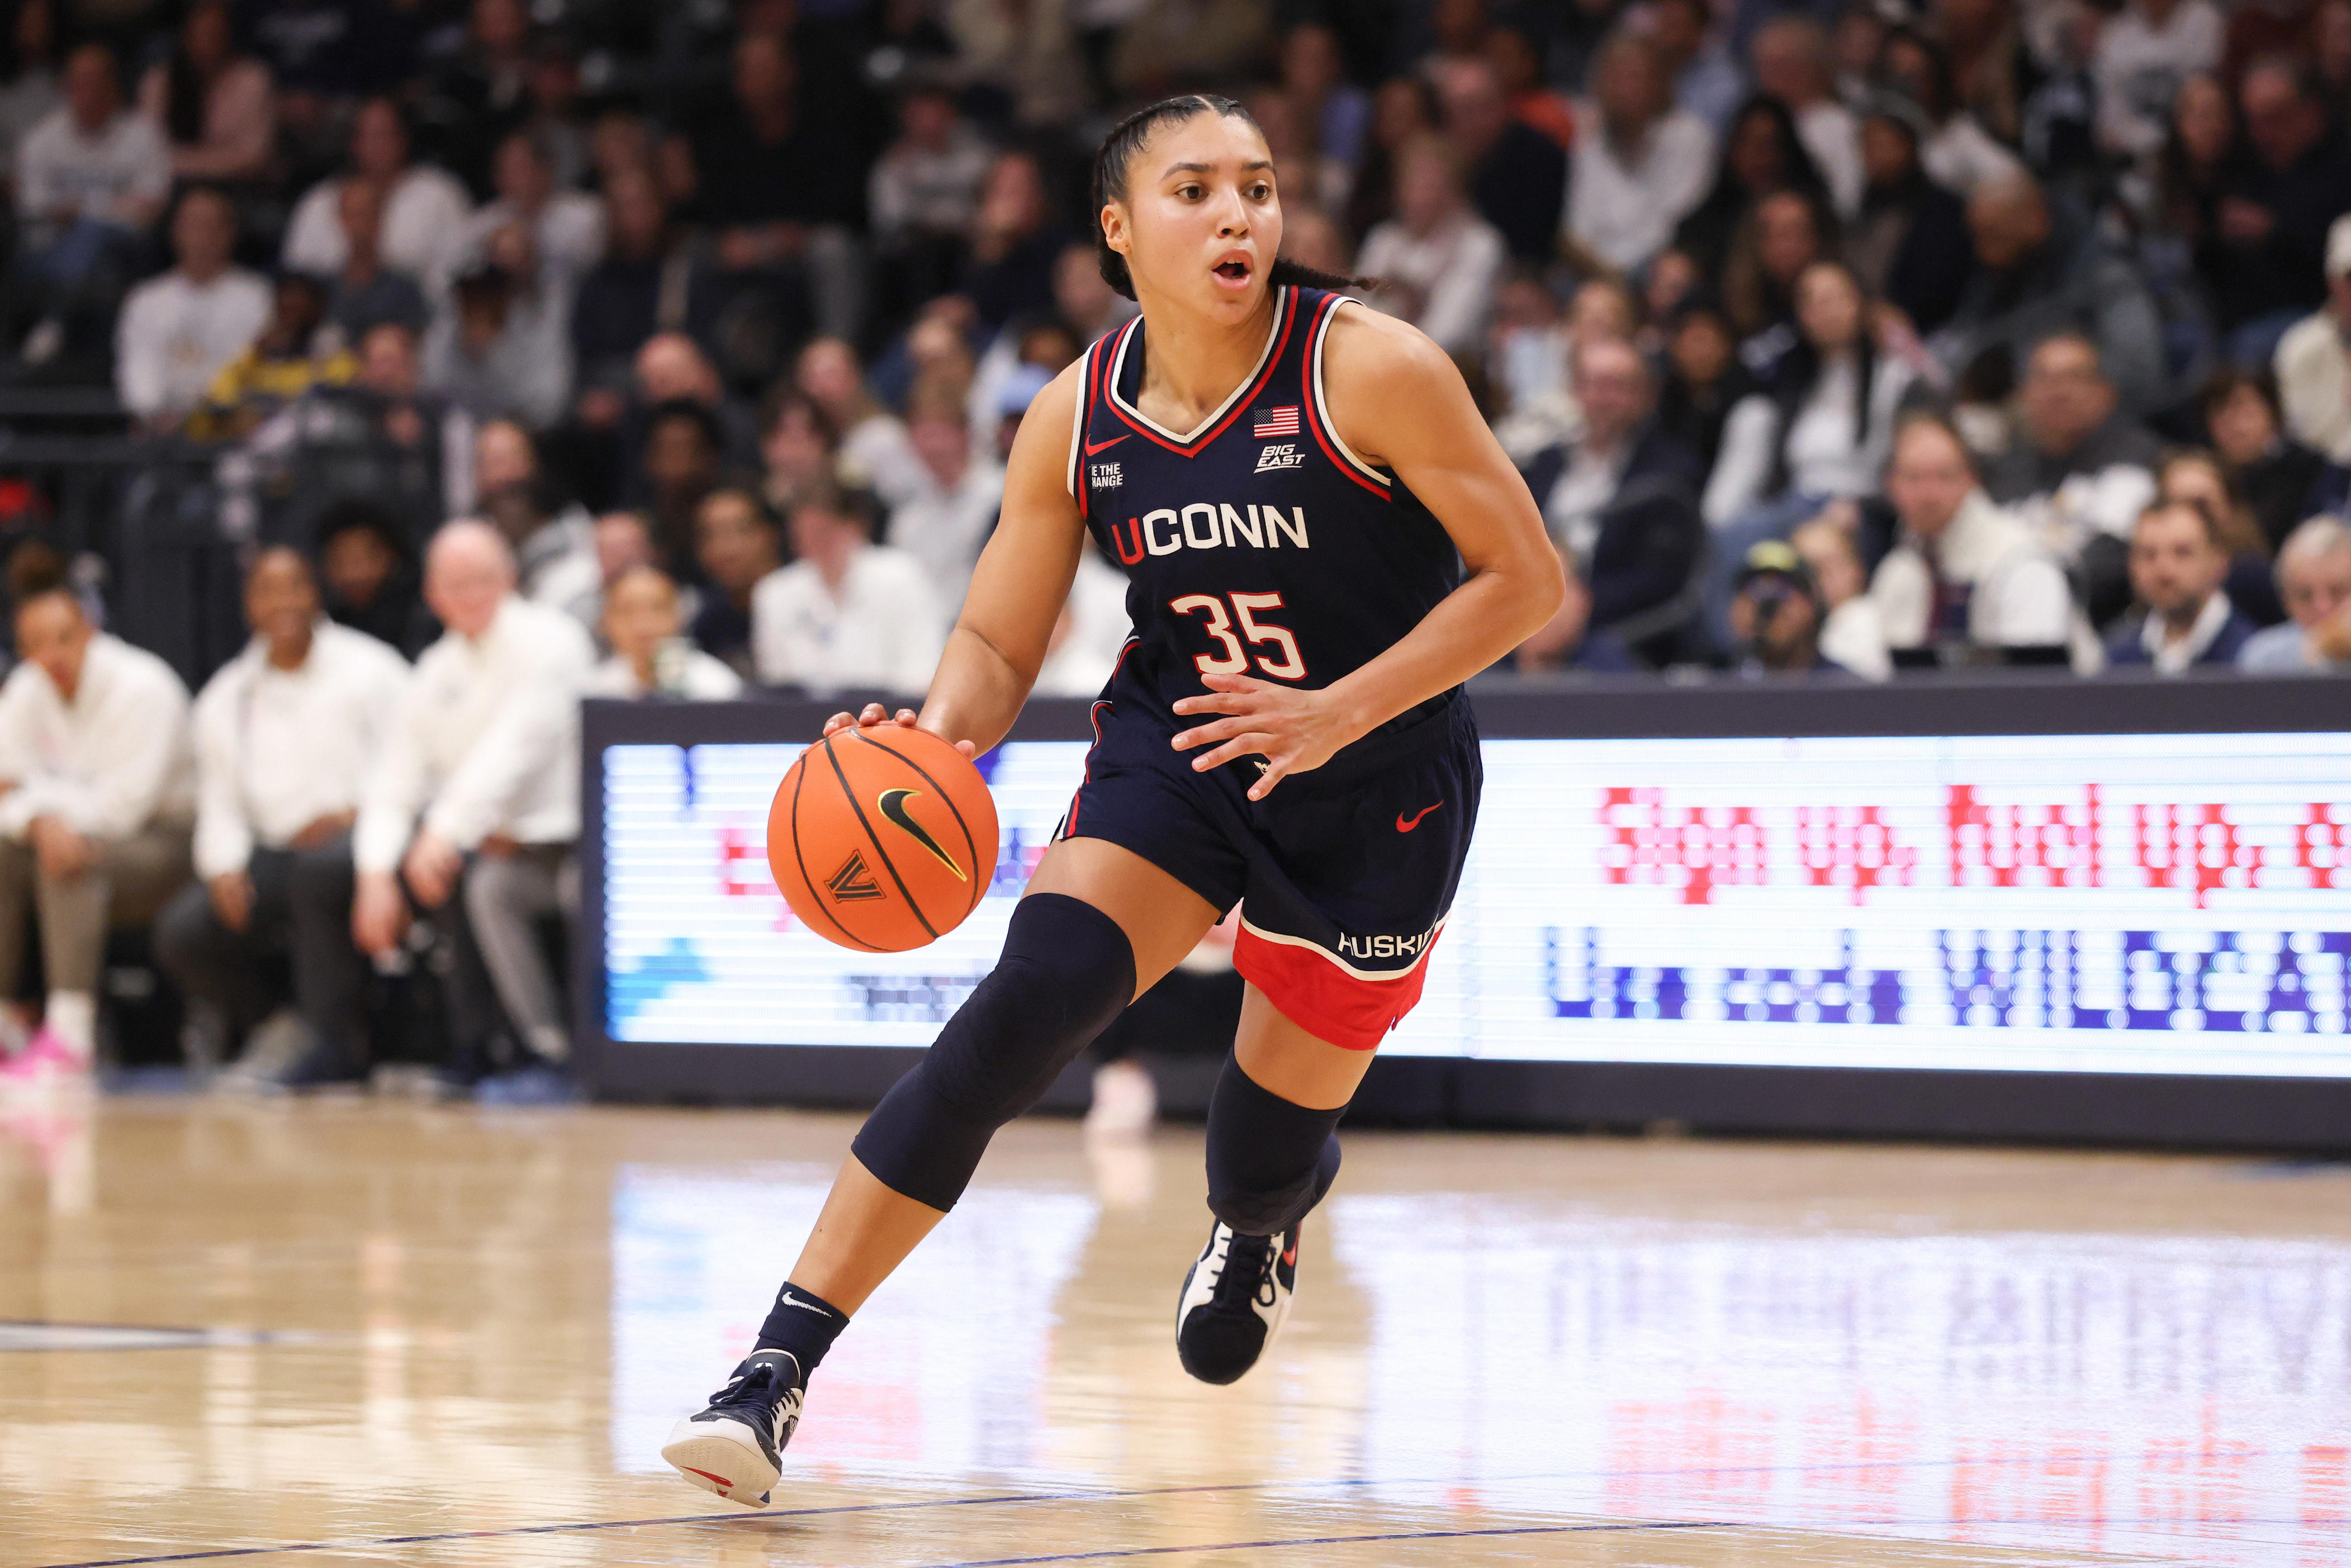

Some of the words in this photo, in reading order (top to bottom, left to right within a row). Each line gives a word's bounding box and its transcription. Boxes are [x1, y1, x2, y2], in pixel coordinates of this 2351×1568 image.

[1261, 444, 1296, 457] BIG
[1257, 454, 1306, 467] EAST
[1092, 465, 1098, 476] E
[1099, 463, 1120, 476] THE
[1092, 474, 1124, 487] HANGE
[1112, 503, 1310, 565] UCONN
[1168, 590, 1309, 681] 35
